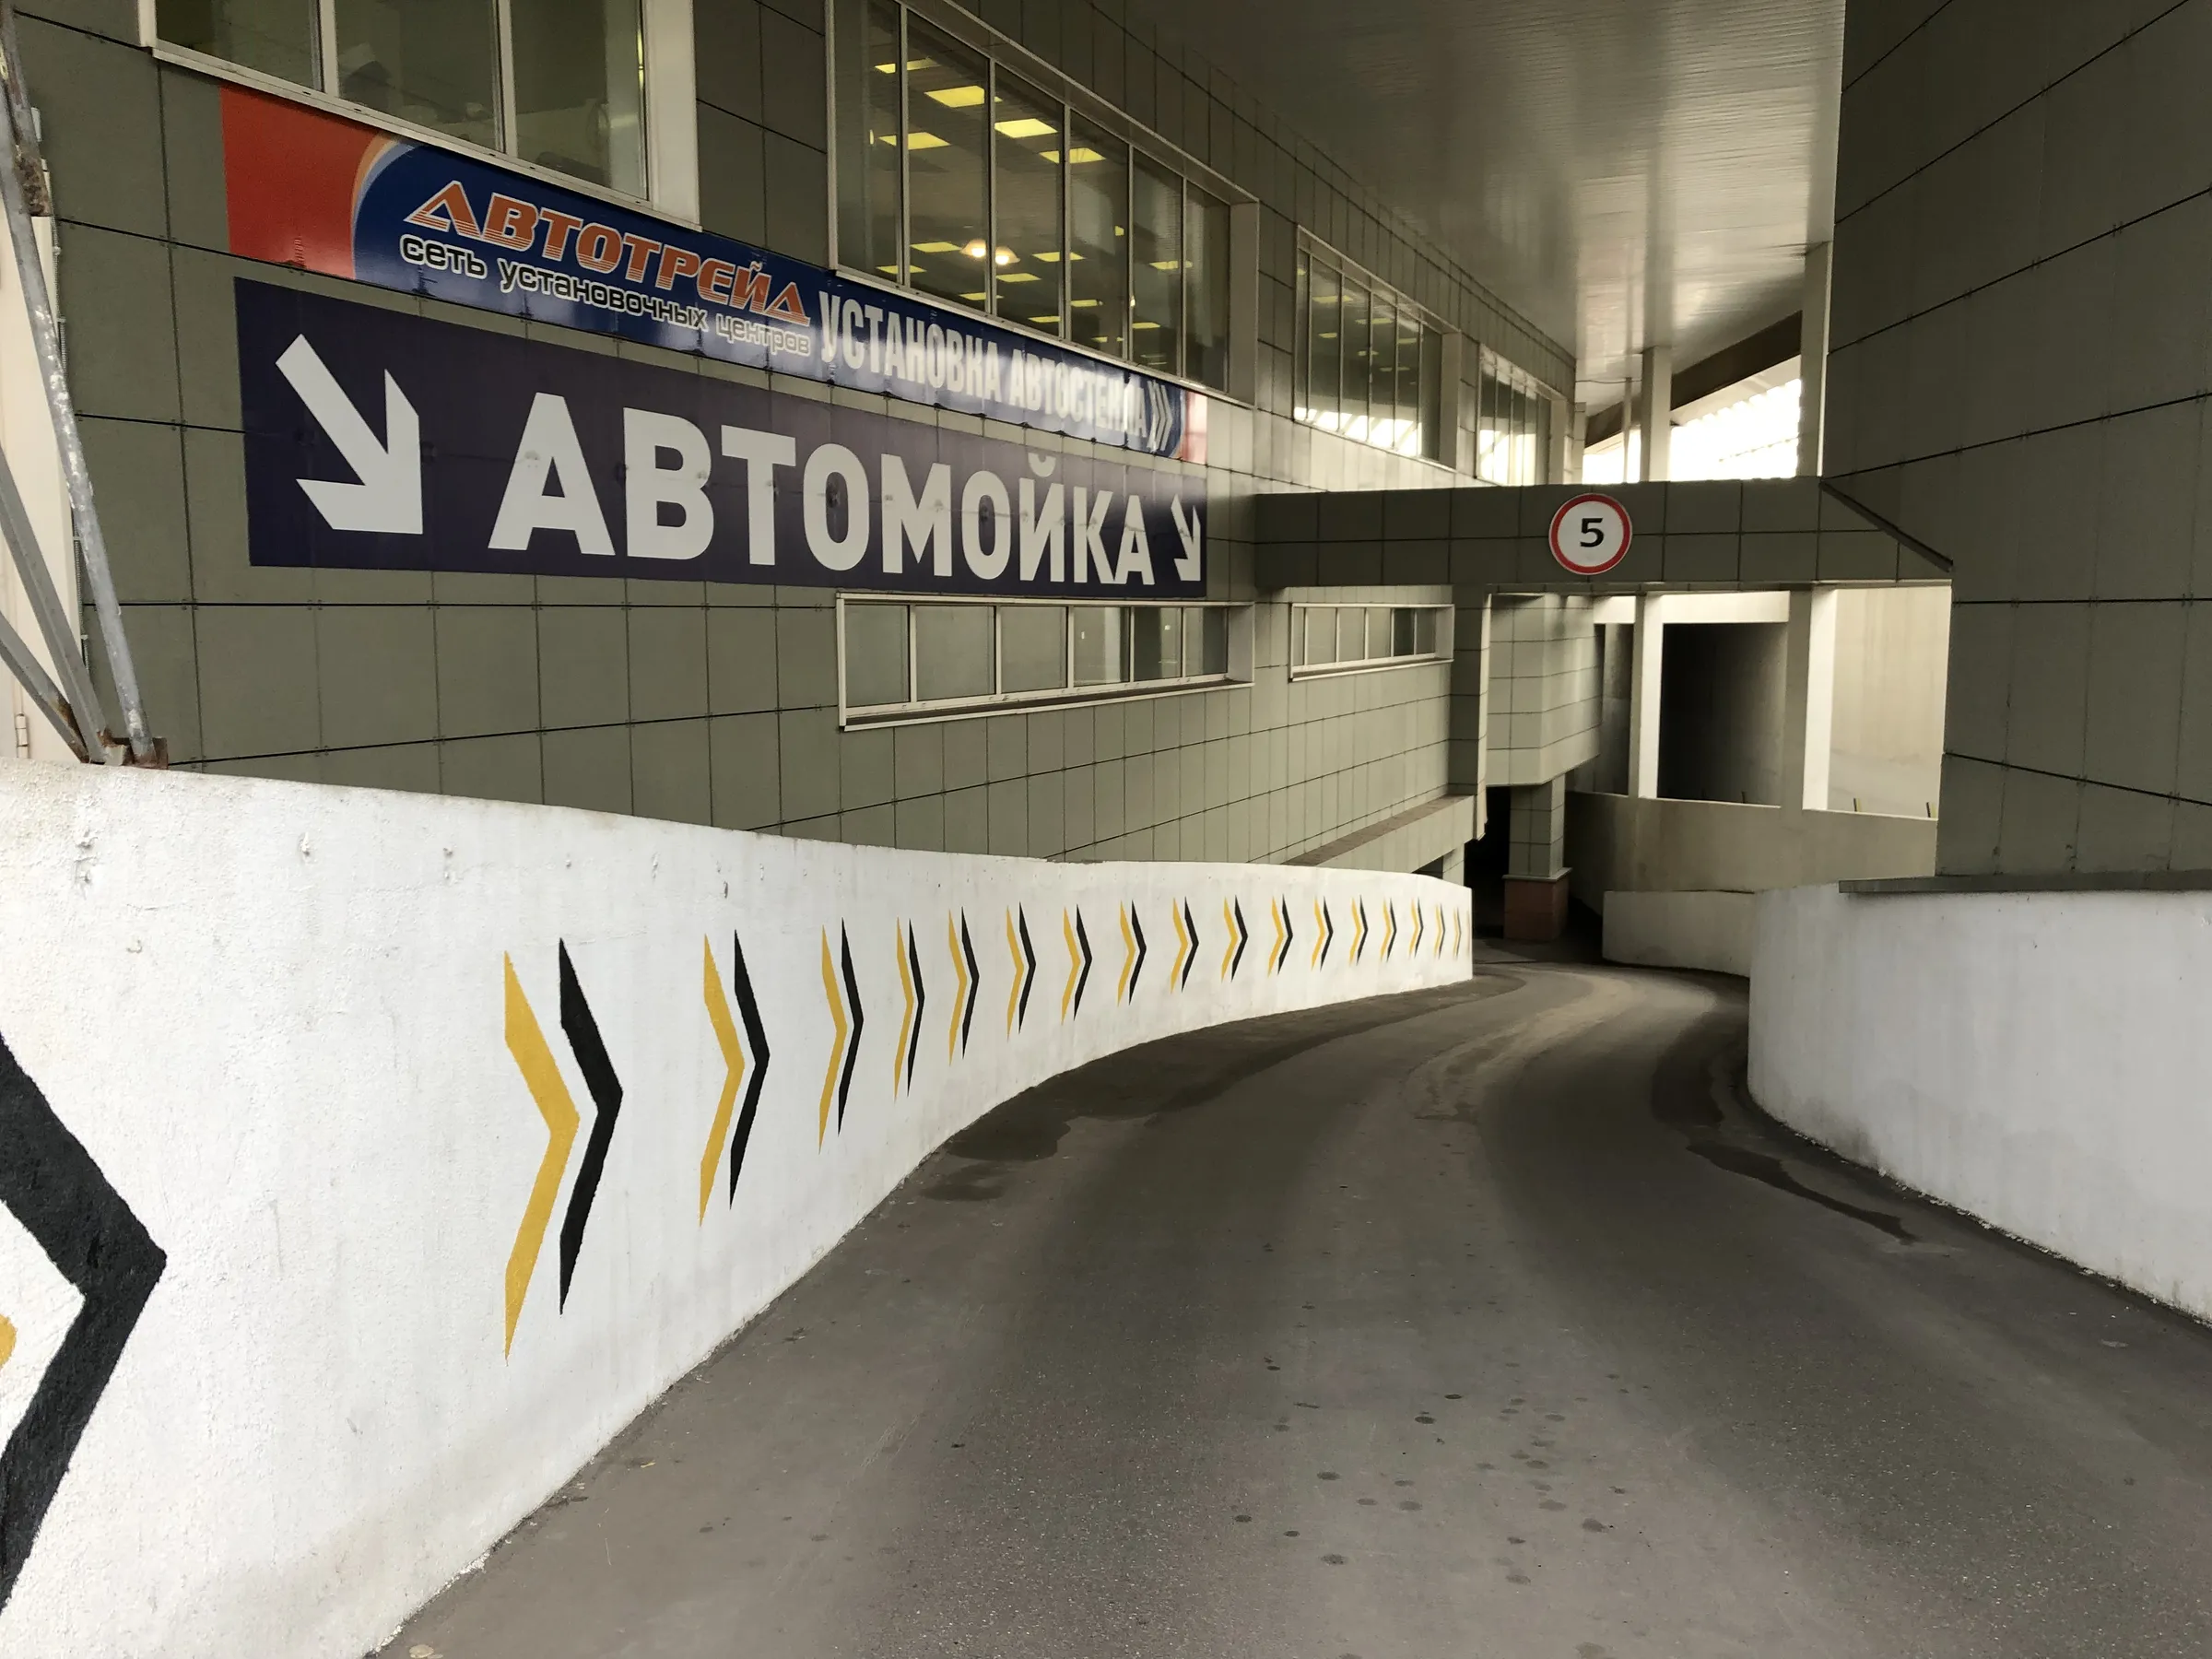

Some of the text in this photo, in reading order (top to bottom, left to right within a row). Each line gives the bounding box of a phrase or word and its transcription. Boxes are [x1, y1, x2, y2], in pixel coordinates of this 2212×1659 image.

[400, 234, 810, 357] сеть установочных центров
[404, 181, 811, 326] АВТОТРЕЙД
[818, 290, 1001, 403] УСТАНОВКА
[488, 393, 1155, 585] АВТОМОЙКА
[1580, 518, 1605, 547] 5
